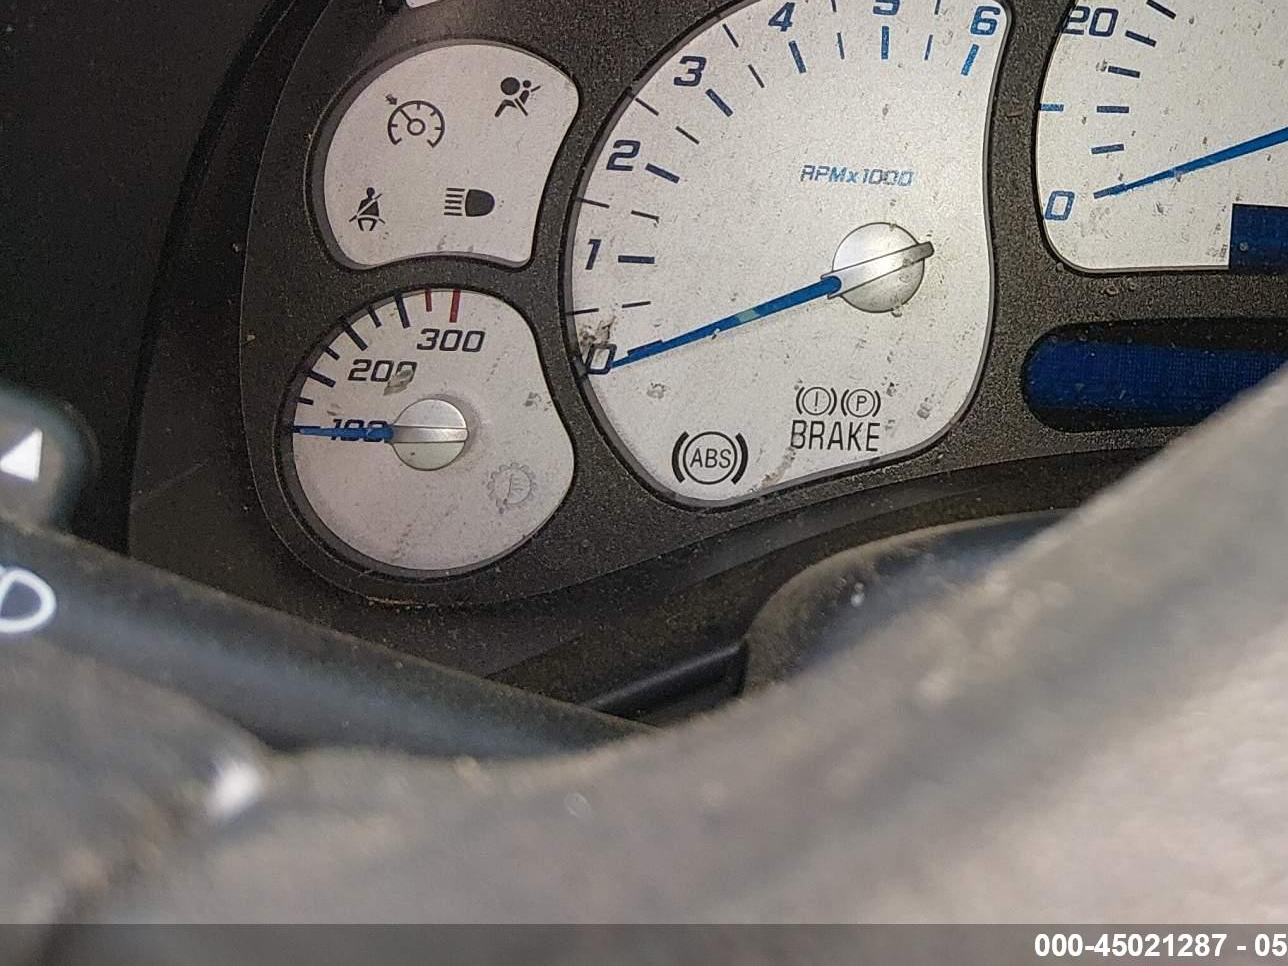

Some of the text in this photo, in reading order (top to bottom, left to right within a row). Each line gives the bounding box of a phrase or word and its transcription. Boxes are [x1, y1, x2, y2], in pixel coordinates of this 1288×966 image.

[768, 2, 796, 32] 4
[969, 6, 1000, 36] 6
[1059, 5, 1119, 37] 20
[673, 56, 706, 87] 3
[606, 140, 641, 171] 2
[1044, 191, 1075, 221] 0
[585, 239, 602, 270] 1
[417, 328, 486, 353] 300
[348, 359, 417, 383] 200
[585, 343, 618, 375] 0
[790, 419, 881, 452] BRAKE
[690, 448, 732, 469] ABS
